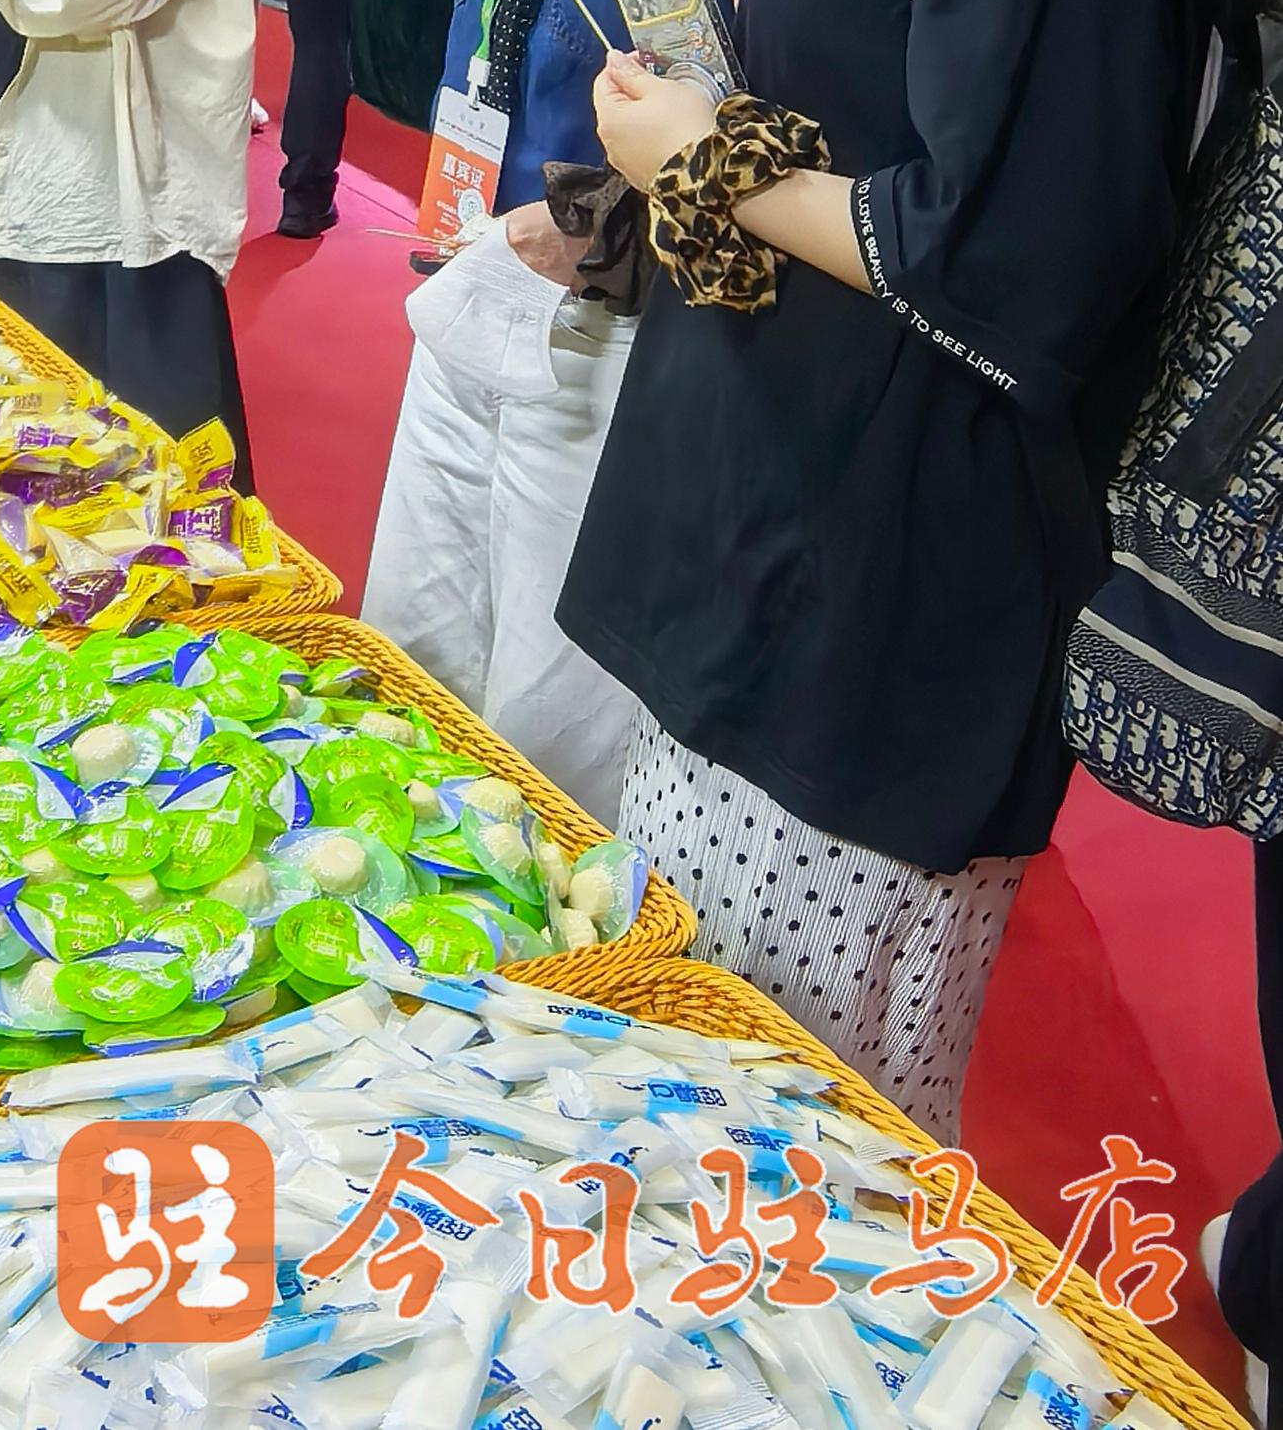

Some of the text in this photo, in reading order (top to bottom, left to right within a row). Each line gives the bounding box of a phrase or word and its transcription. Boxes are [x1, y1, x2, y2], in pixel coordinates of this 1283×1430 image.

[857, 194, 875, 236] LOVE
[891, 297, 910, 315] IS
[910, 310, 930, 333] TO
[932, 329, 967, 357] SEE
[966, 350, 1018, 391] LIGHT
